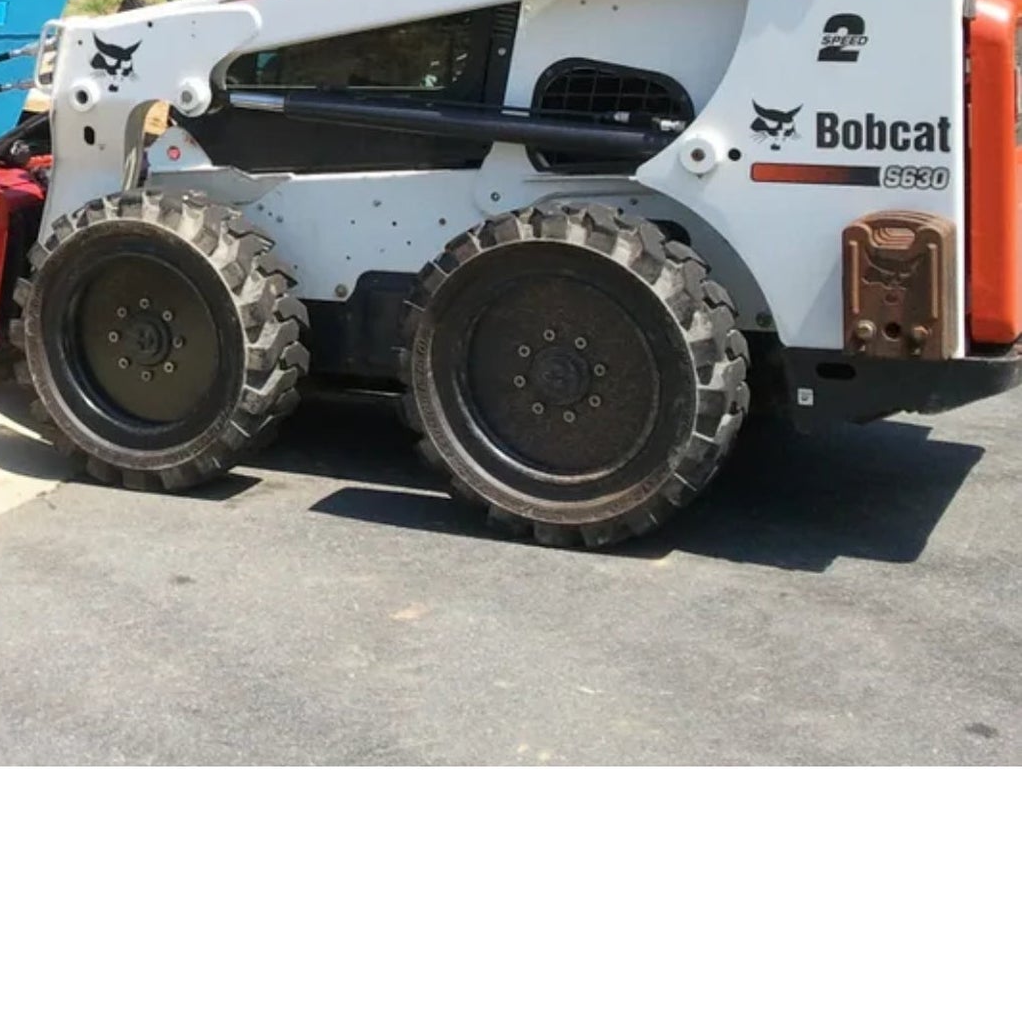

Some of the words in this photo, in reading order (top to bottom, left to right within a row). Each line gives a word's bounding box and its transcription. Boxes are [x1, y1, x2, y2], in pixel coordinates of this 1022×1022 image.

[817, 13, 866, 62] 2
[821, 35, 869, 47] SPEED
[815, 111, 952, 153] Bobcat
[882, 164, 950, 190] S630
